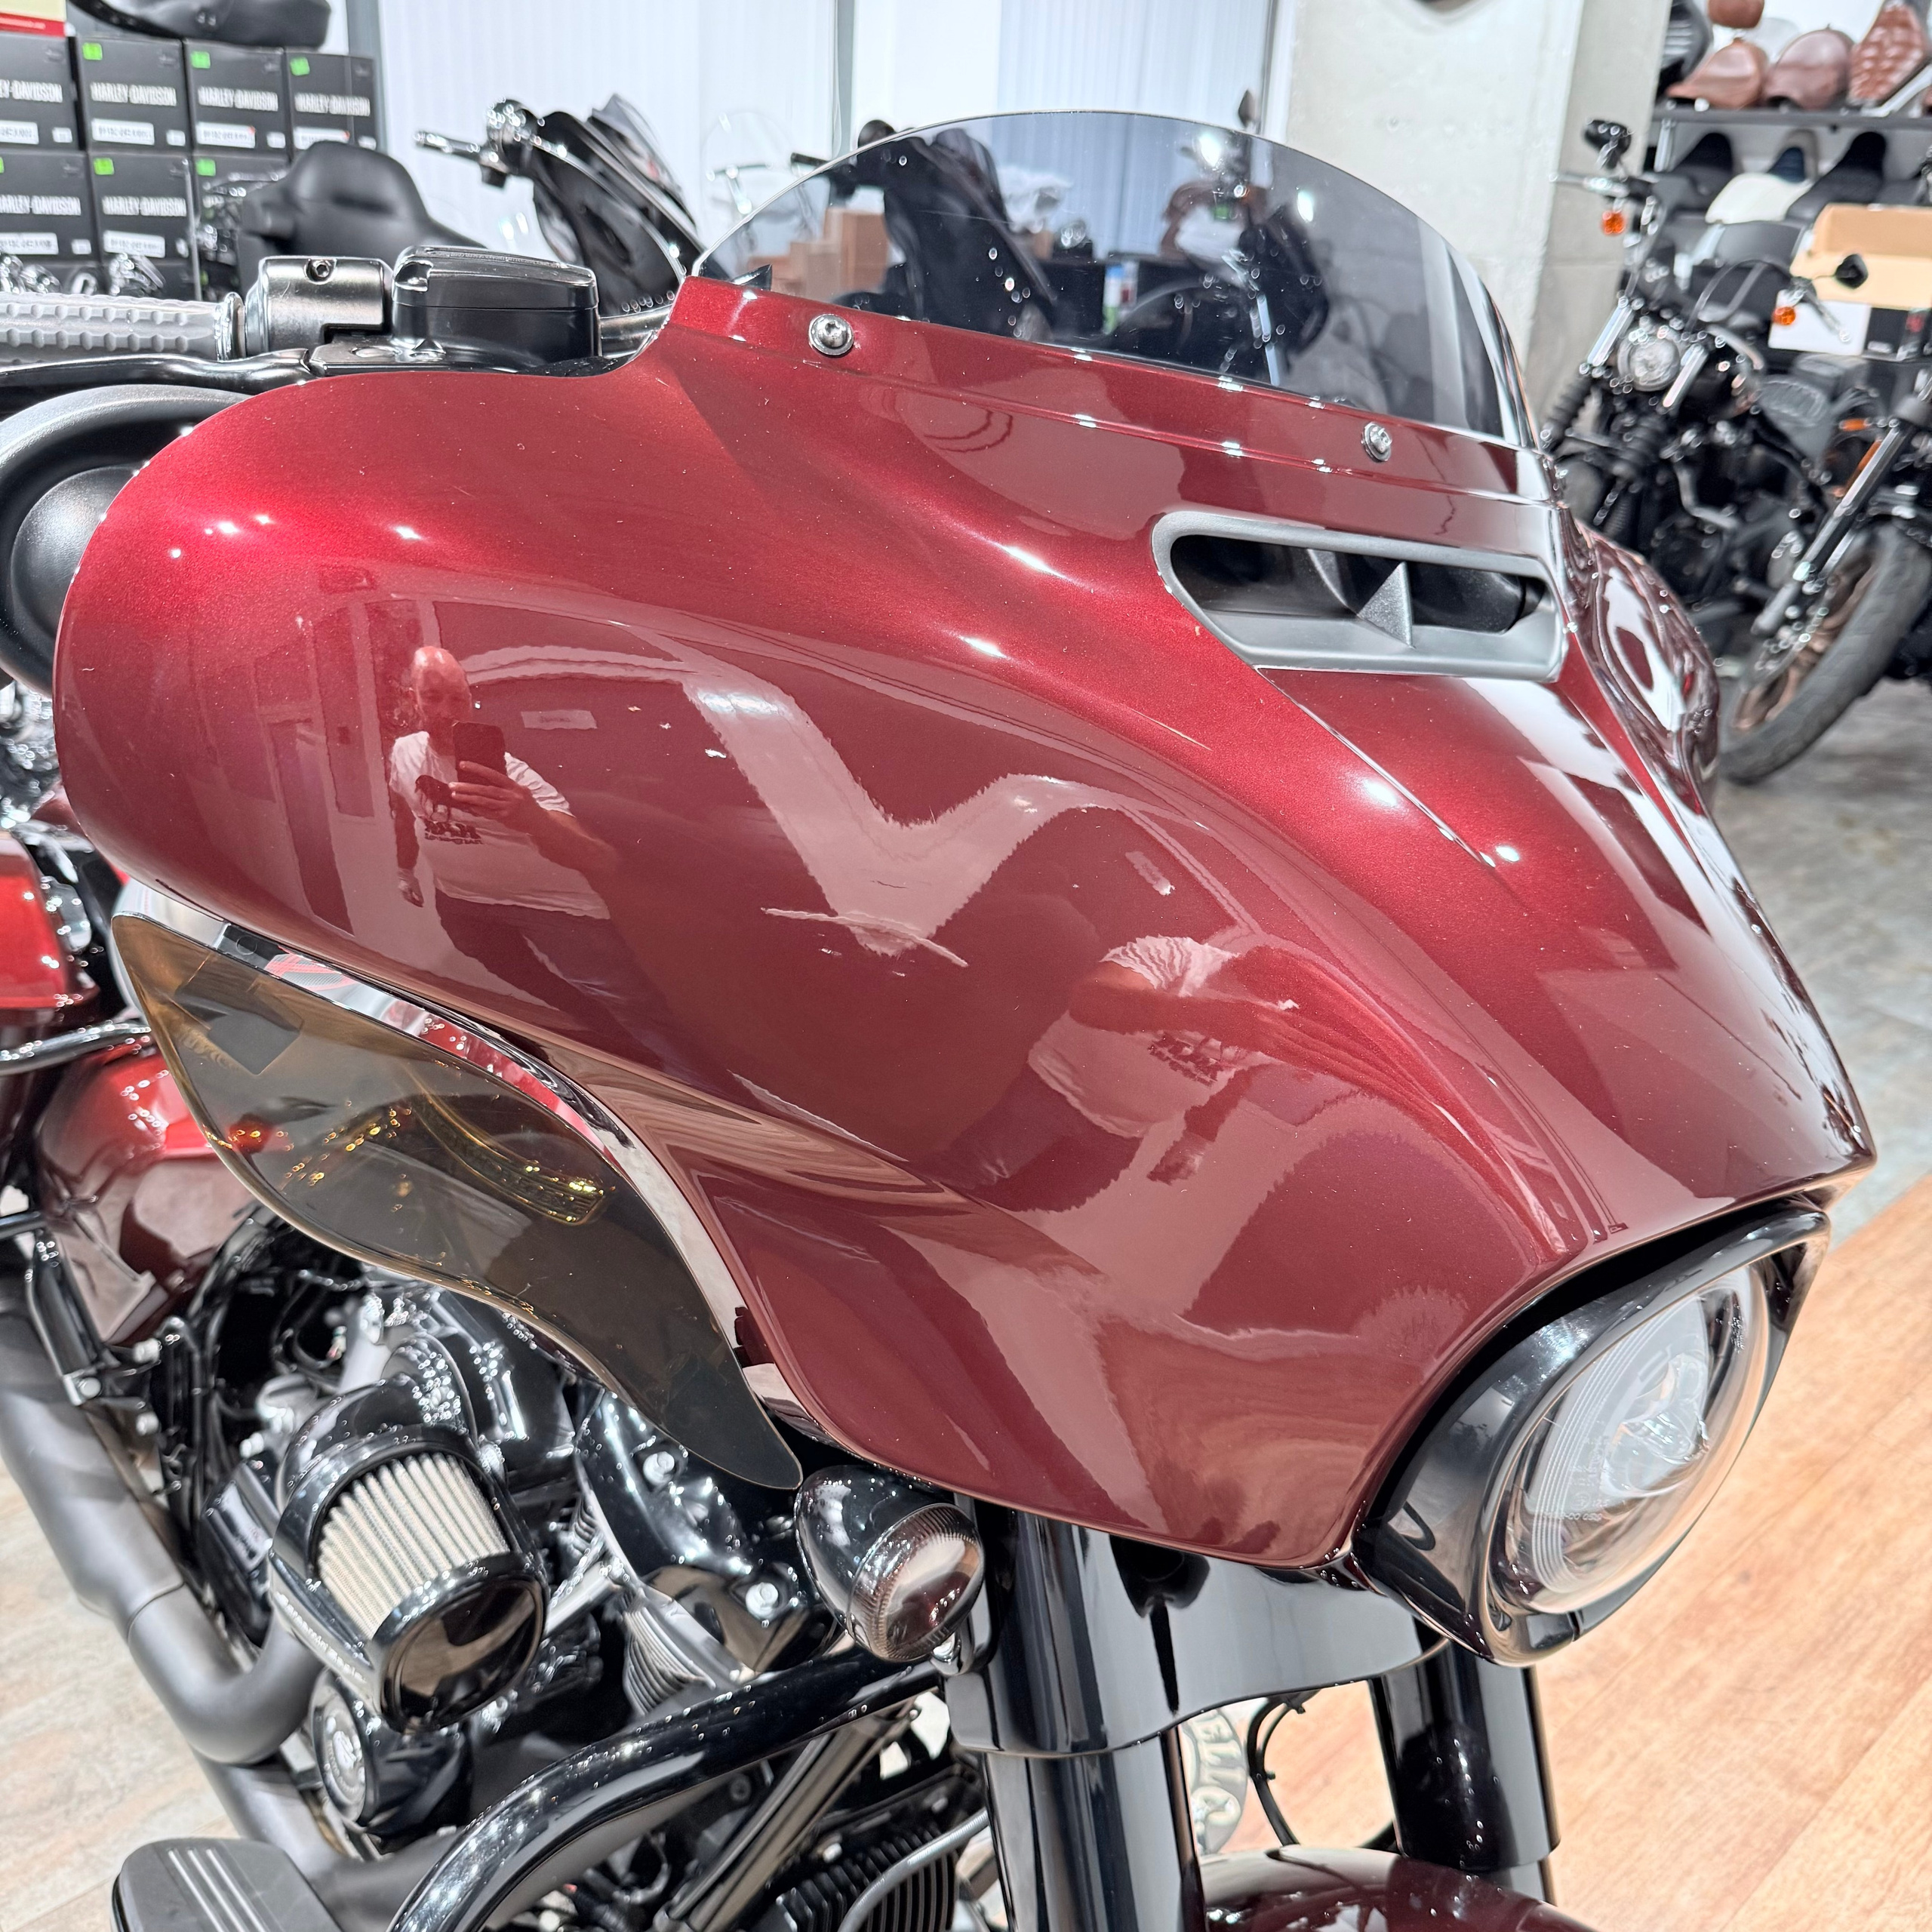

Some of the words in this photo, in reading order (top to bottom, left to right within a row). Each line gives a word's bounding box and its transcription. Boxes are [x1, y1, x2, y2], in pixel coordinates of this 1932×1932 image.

[89, 82, 177, 106] HARLEY-DAVIDSON
[198, 86, 278, 112] HARLEY-DAVIDSON
[294, 92, 371, 117] HARLEY-DAVIDSON
[0, 195, 82, 216] ARLEY-DAVIDSON
[102, 195, 187, 217] HARLEY-DAVIDSON
